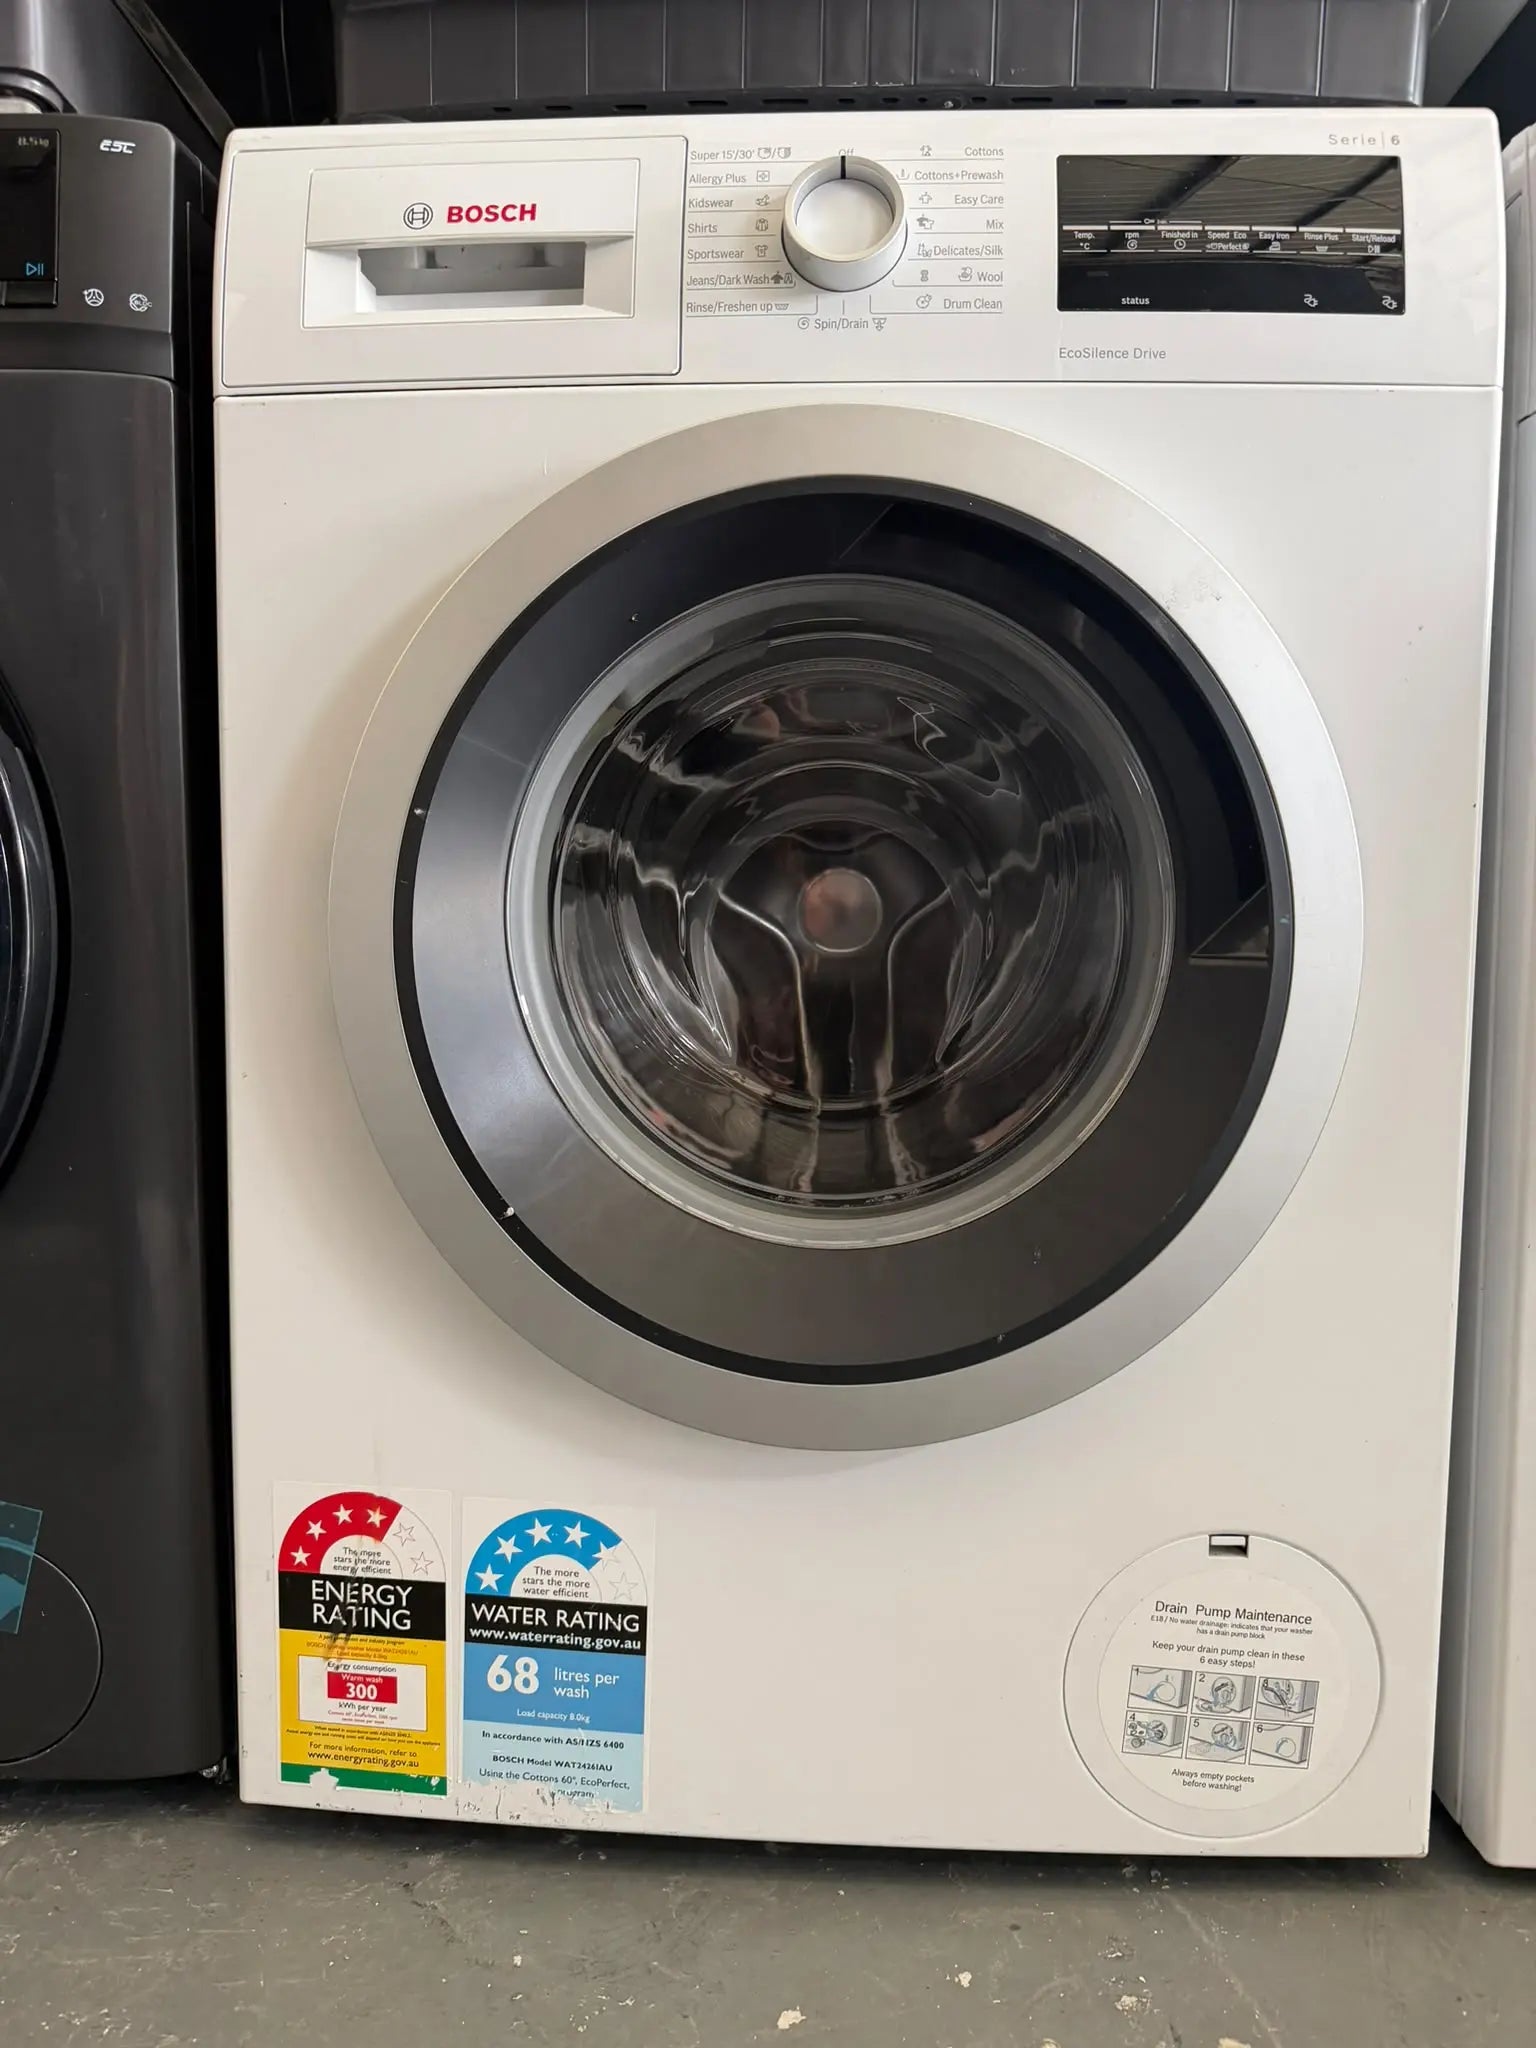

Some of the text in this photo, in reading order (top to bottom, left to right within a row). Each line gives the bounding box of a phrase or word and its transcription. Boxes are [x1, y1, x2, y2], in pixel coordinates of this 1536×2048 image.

[1328, 134, 1400, 145] Serie 6
[691, 151, 719, 161] Super
[965, 147, 1004, 156] Cottons
[689, 174, 746, 184] Allergy Plus
[915, 171, 1003, 181] Cottons+Prewash
[688, 199, 733, 208] Kidswear
[955, 194, 1004, 206] Easy Care
[447, 203, 536, 223] BOSCH
[688, 224, 718, 233] Shirts
[986, 219, 1004, 229] Mix
[1074, 231, 1095, 239] Temp.
[1162, 231, 1198, 239] Finished in
[1208, 232, 1229, 240] Speed
[1352, 234, 1396, 244] Start/Reload
[688, 249, 744, 260] Sportswear
[934, 245, 1003, 256] Delicates/Silk
[687, 274, 769, 286] Jeans/Dark Wash
[977, 272, 1003, 282] Wool
[944, 299, 1002, 309] Drum Clean
[1121, 297, 1150, 305] status
[686, 302, 773, 313] Rinse/Freshen up
[814, 318, 868, 331] Spin/Drain
[1059, 347, 1166, 359] EcoSilence Drive
[361, 1566, 391, 1574] efficient
[534, 1566, 579, 1577] The more
[522, 1577, 590, 1588] stars the more
[312, 1579, 412, 1607] ENERGY
[553, 1588, 589, 1598] efficient
[313, 1603, 411, 1630] RATING
[472, 1603, 639, 1632] WATER RATING
[1155, 1601, 1312, 1624] Drain Pump Maintenance
[469, 1628, 640, 1650] www.waterrating.gov.au
[1152, 1640, 1305, 1661] Keep your drain pump clean in these
[328, 1661, 351, 1670] Enrgy
[1200, 1656, 1255, 1669] 6 easy steps!
[487, 1654, 539, 1694] 68
[554, 1668, 619, 1687] litres per
[1199, 1674, 1205, 1683] 2
[346, 1683, 377, 1700] 300
[554, 1686, 589, 1698] wash
[517, 1709, 535, 1717] Load
[537, 1712, 567, 1721] capacity
[1129, 1713, 1135, 1722] 4
[1193, 1718, 1199, 1727] 5
[1256, 1724, 1263, 1733] 6
[482, 1730, 490, 1738] In
[493, 1733, 541, 1743] accordance
[544, 1737, 563, 1745] with
[604, 1740, 624, 1749] 6400
[345, 1745, 387, 1755] information,
[308, 1752, 419, 1768] www.energyrating.gov.au
[493, 1755, 524, 1764] BOSCH
[527, 1758, 551, 1766] Model
[480, 1768, 503, 1778] Using
[506, 1770, 519, 1779] the
[522, 1773, 558, 1783] Cottons
[581, 1777, 630, 1790] EcoPerfect,
[1172, 1768, 1254, 1783] Always empty pockets
[1182, 1779, 1242, 1792] before washing!
